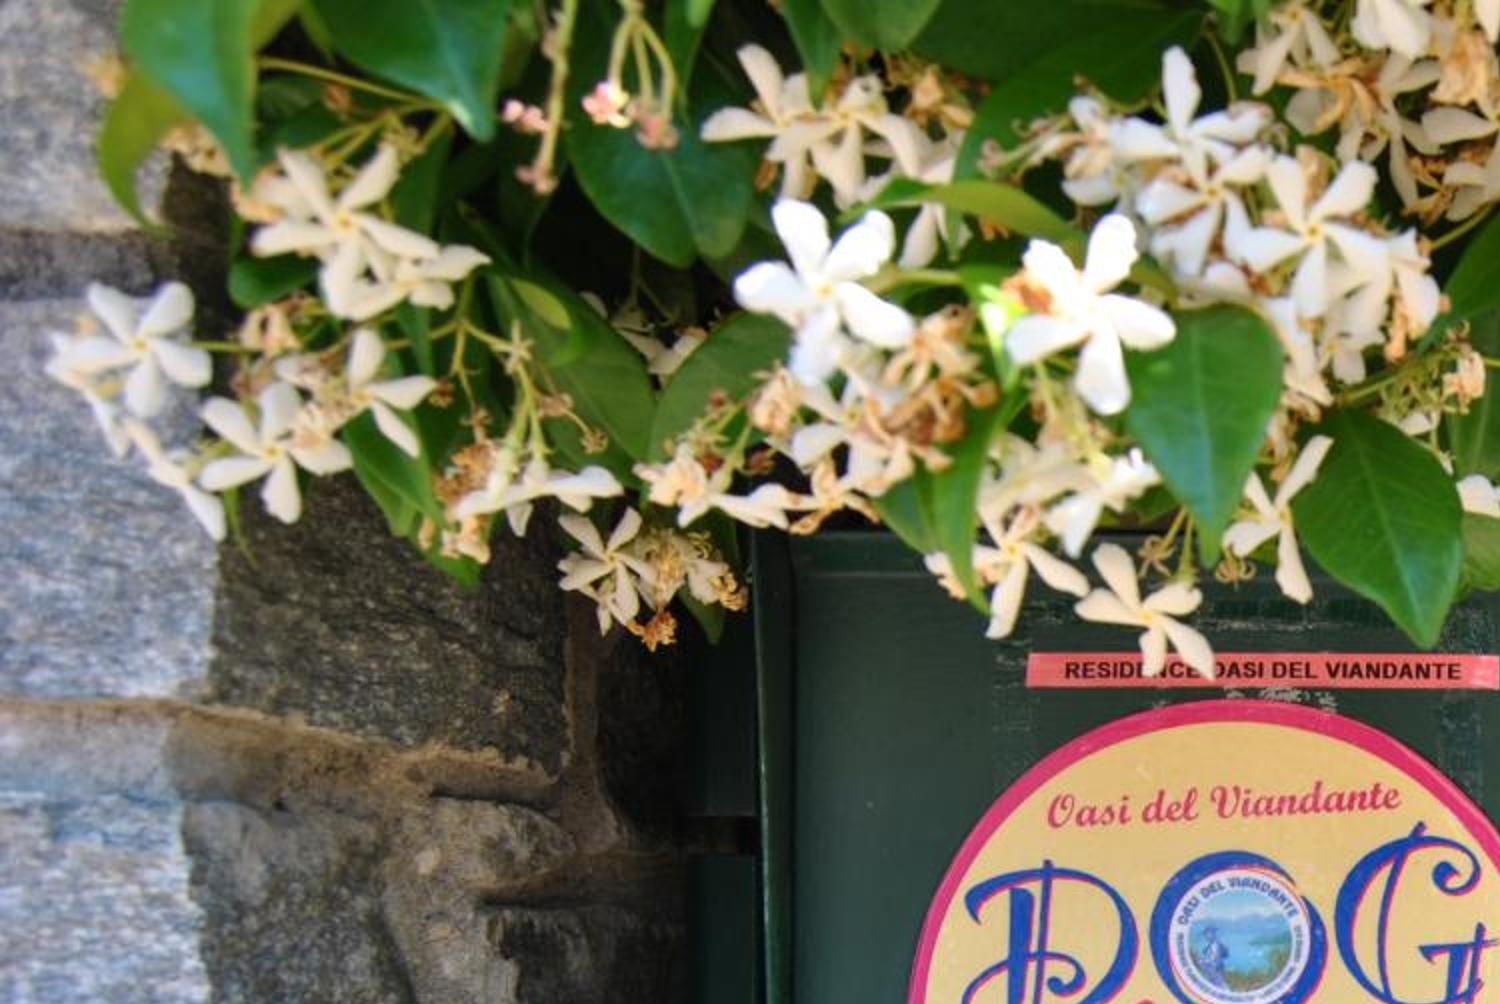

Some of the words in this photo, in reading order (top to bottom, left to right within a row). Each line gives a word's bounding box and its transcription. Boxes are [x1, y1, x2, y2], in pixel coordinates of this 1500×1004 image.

[1213, 661, 1264, 679] OASI
[1271, 661, 1317, 679] DEL
[1325, 662, 1462, 679] VIANDANTE
[1048, 793, 1130, 828] Oasi
[1142, 787, 1199, 823] del
[1211, 781, 1402, 819] Viandante
